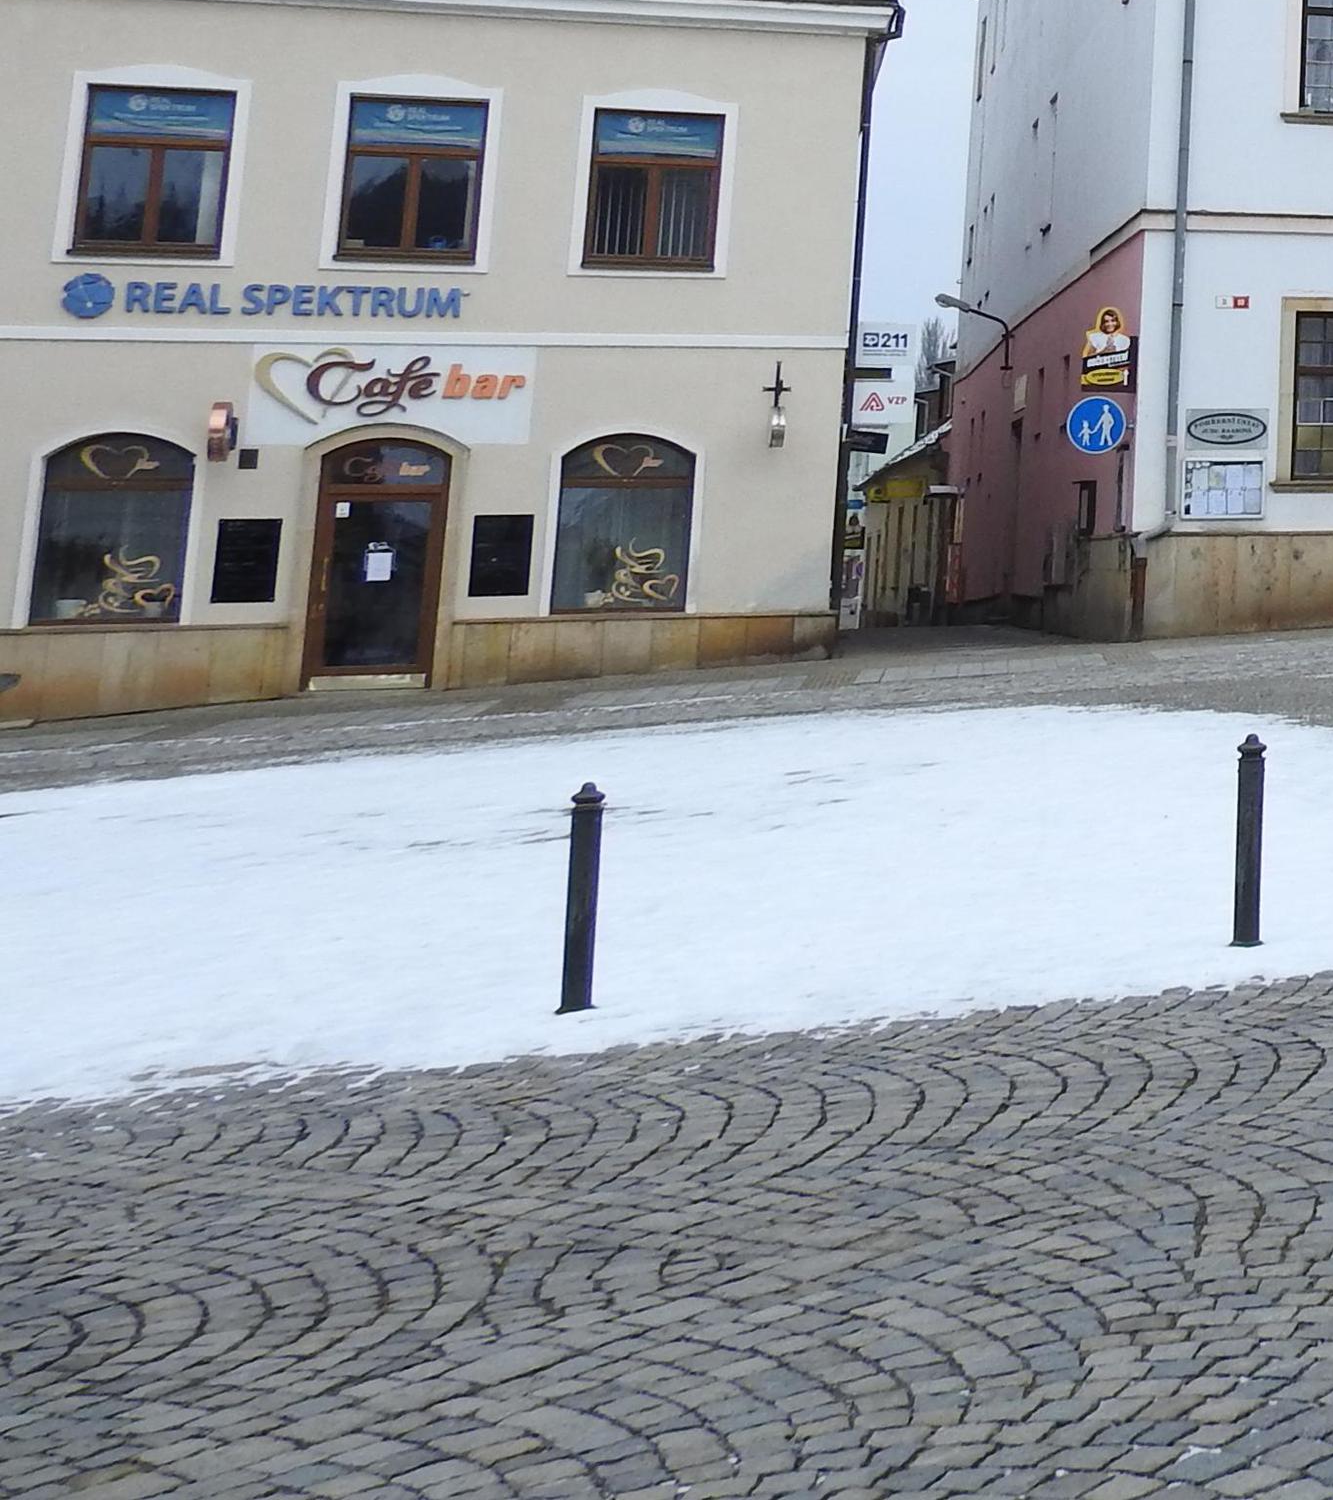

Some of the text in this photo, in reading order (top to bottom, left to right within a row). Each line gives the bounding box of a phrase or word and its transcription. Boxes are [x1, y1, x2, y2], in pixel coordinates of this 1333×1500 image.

[124, 282, 462, 319] REAL SPEKTRUM
[881, 333, 909, 348] 211
[441, 364, 526, 400] bar
[888, 396, 908, 405] VZP
